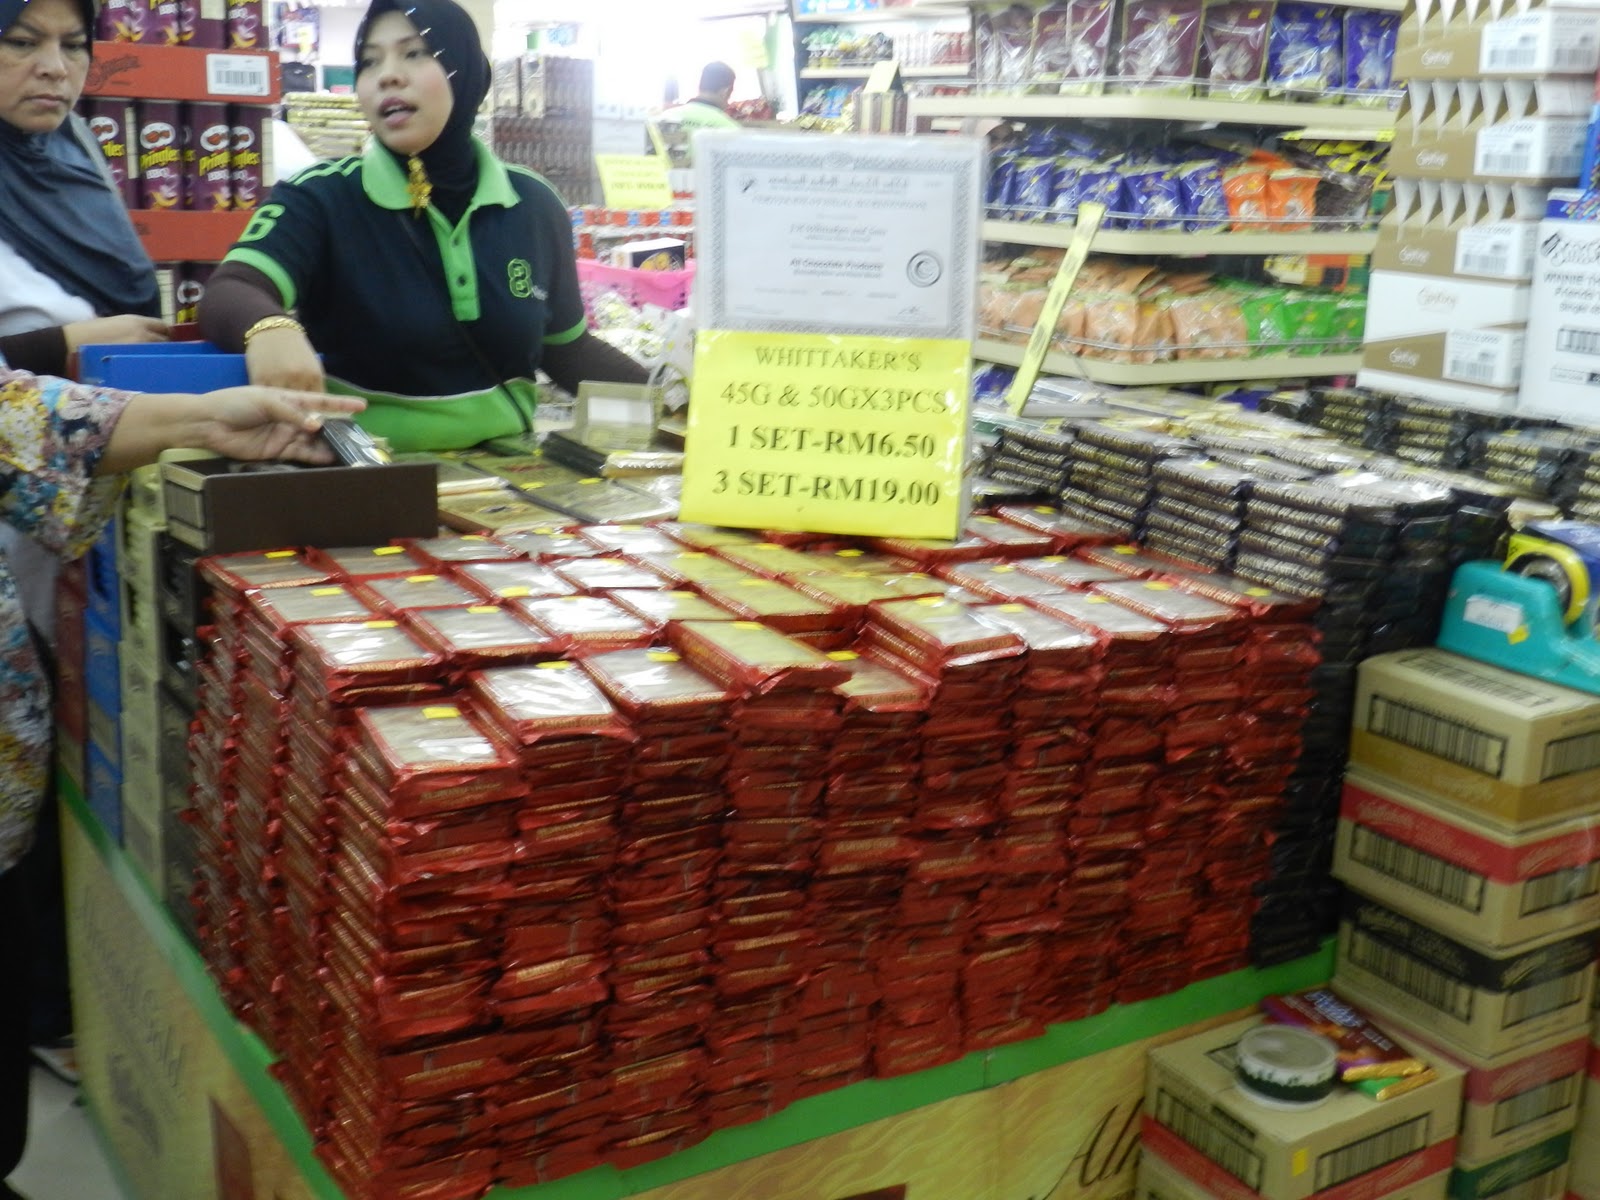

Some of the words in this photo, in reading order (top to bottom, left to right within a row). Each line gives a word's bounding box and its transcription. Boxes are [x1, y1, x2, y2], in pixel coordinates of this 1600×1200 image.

[755, 346, 922, 373] WHITTAKER'S
[720, 382, 772, 406] 45G
[777, 384, 801, 407] &
[807, 384, 948, 413] 50GX3PCS
[727, 425, 740, 448] 1
[750, 425, 936, 459] SET-RM6.50
[712, 470, 729, 494] 3
[737, 471, 939, 506] SET-RM19.00
